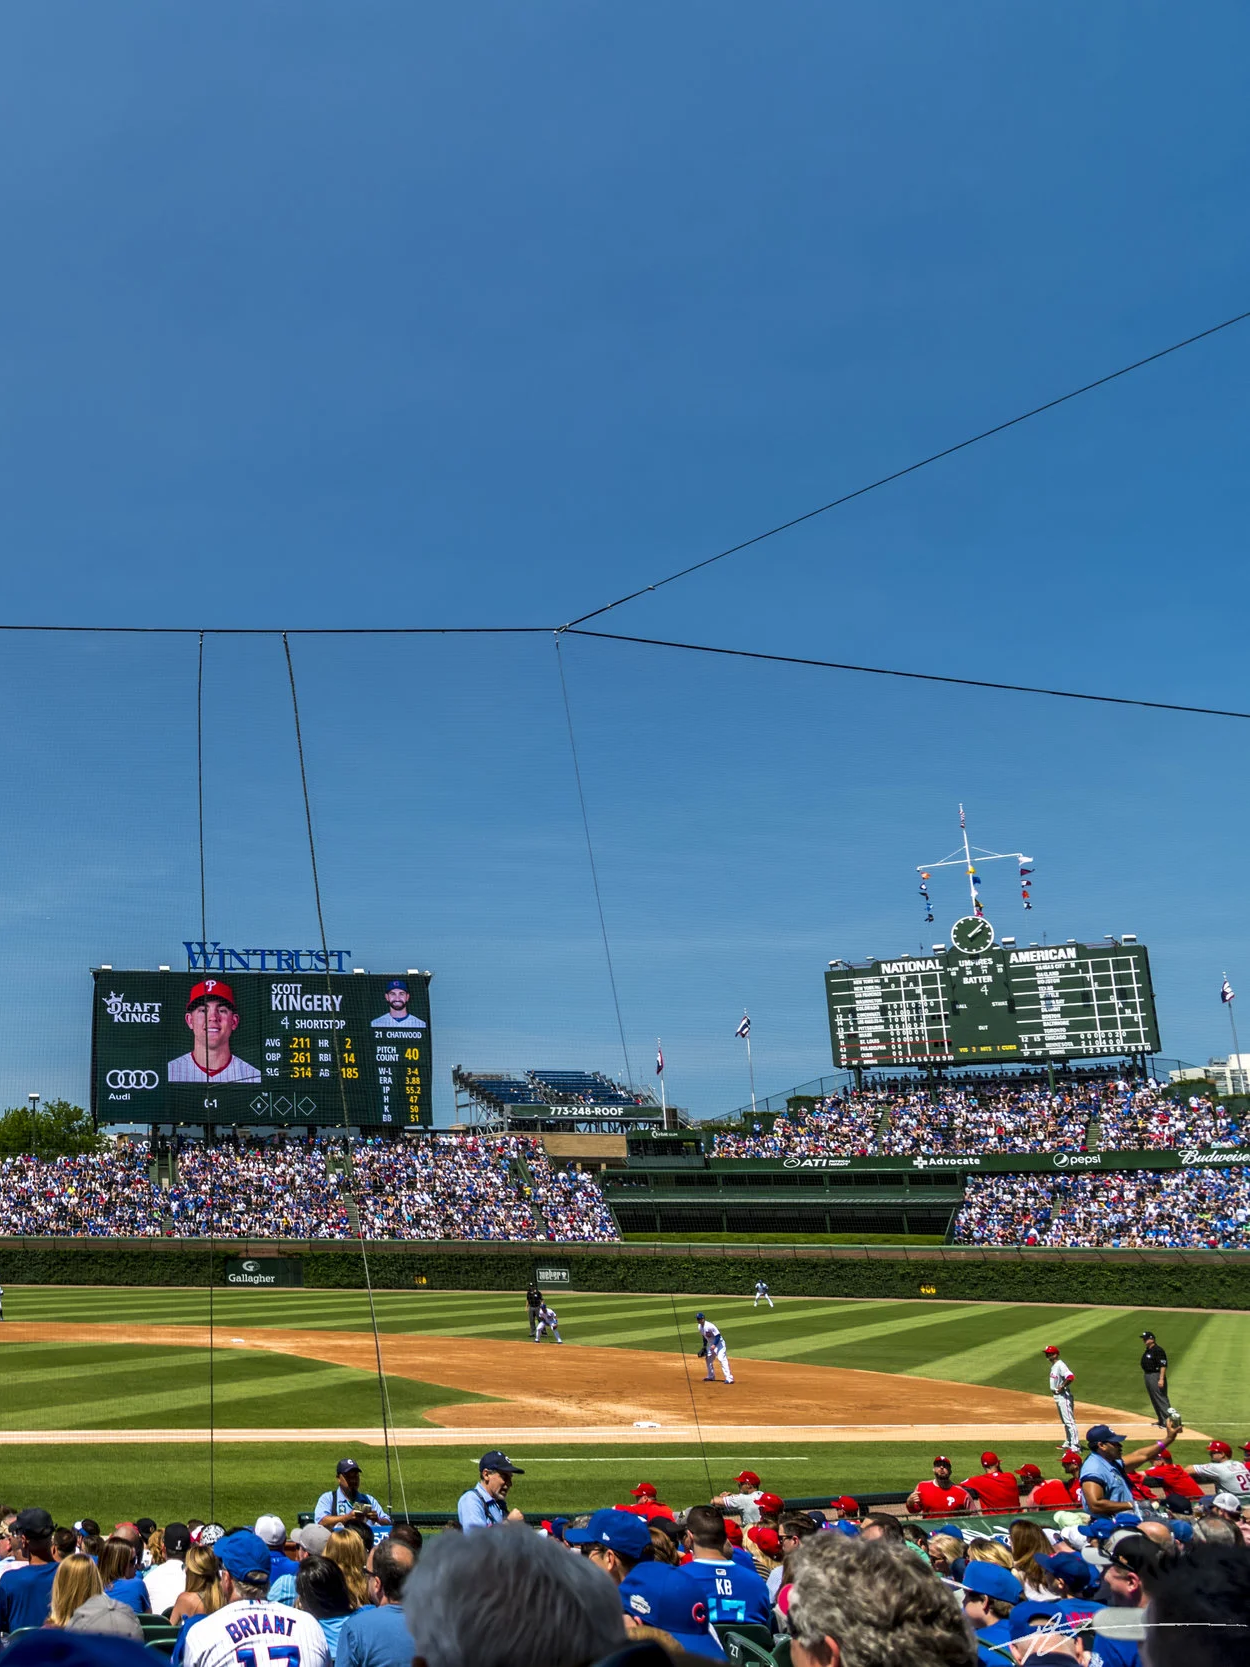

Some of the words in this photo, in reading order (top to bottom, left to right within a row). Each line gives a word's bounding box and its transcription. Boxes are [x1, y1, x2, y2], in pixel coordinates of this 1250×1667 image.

[182, 942, 352, 972] WINTRUST
[1010, 948, 1077, 964] AMERICAN
[881, 960, 943, 974] NATIONAL
[958, 958, 993, 967] UMPIRES
[963, 976, 993, 984] BATTER
[272, 984, 302, 994] SCOTT
[980, 984, 989, 995] 4
[107, 1002, 162, 1015] DRAFT
[272, 995, 343, 1012] KINGERY
[114, 1012, 160, 1023] KINGS
[281, 1016, 290, 1029] 4
[295, 1020, 346, 1030] SHORTSTOP
[265, 1039, 281, 1047] AVG
[290, 1038, 311, 1049] .211
[319, 1039, 329, 1047] HR
[345, 1038, 352, 1049] 2
[377, 1046, 397, 1054] PITCH
[405, 1048, 420, 1061] 40
[266, 1052, 281, 1061] OBP
[290, 1052, 311, 1063] .261
[319, 1053, 332, 1062] RBI
[343, 1053, 356, 1064] 14
[376, 1054, 399, 1062] COUNT
[266, 1068, 280, 1077] SLG
[290, 1067, 312, 1078] .314
[319, 1069, 330, 1077] AB
[341, 1068, 359, 1079] 185
[379, 1077, 393, 1085] ERA
[406, 1077, 420, 1085] 3.88
[383, 1086, 390, 1094] IP
[550, 1107, 624, 1116] 773-248-ROOF
[382, 1114, 392, 1122] BB
[800, 1159, 827, 1167] ATI
[929, 1157, 980, 1165] Advocate
[1070, 1154, 1101, 1166] pepsi
[1178, 1150, 1250, 1165] Budweise
[228, 1274, 275, 1284] Gallagher
[716, 1579, 733, 1596] KB
[692, 1602, 706, 1624] C
[225, 1614, 297, 1644] BRYANT
[730, 1644, 739, 1658] 27
